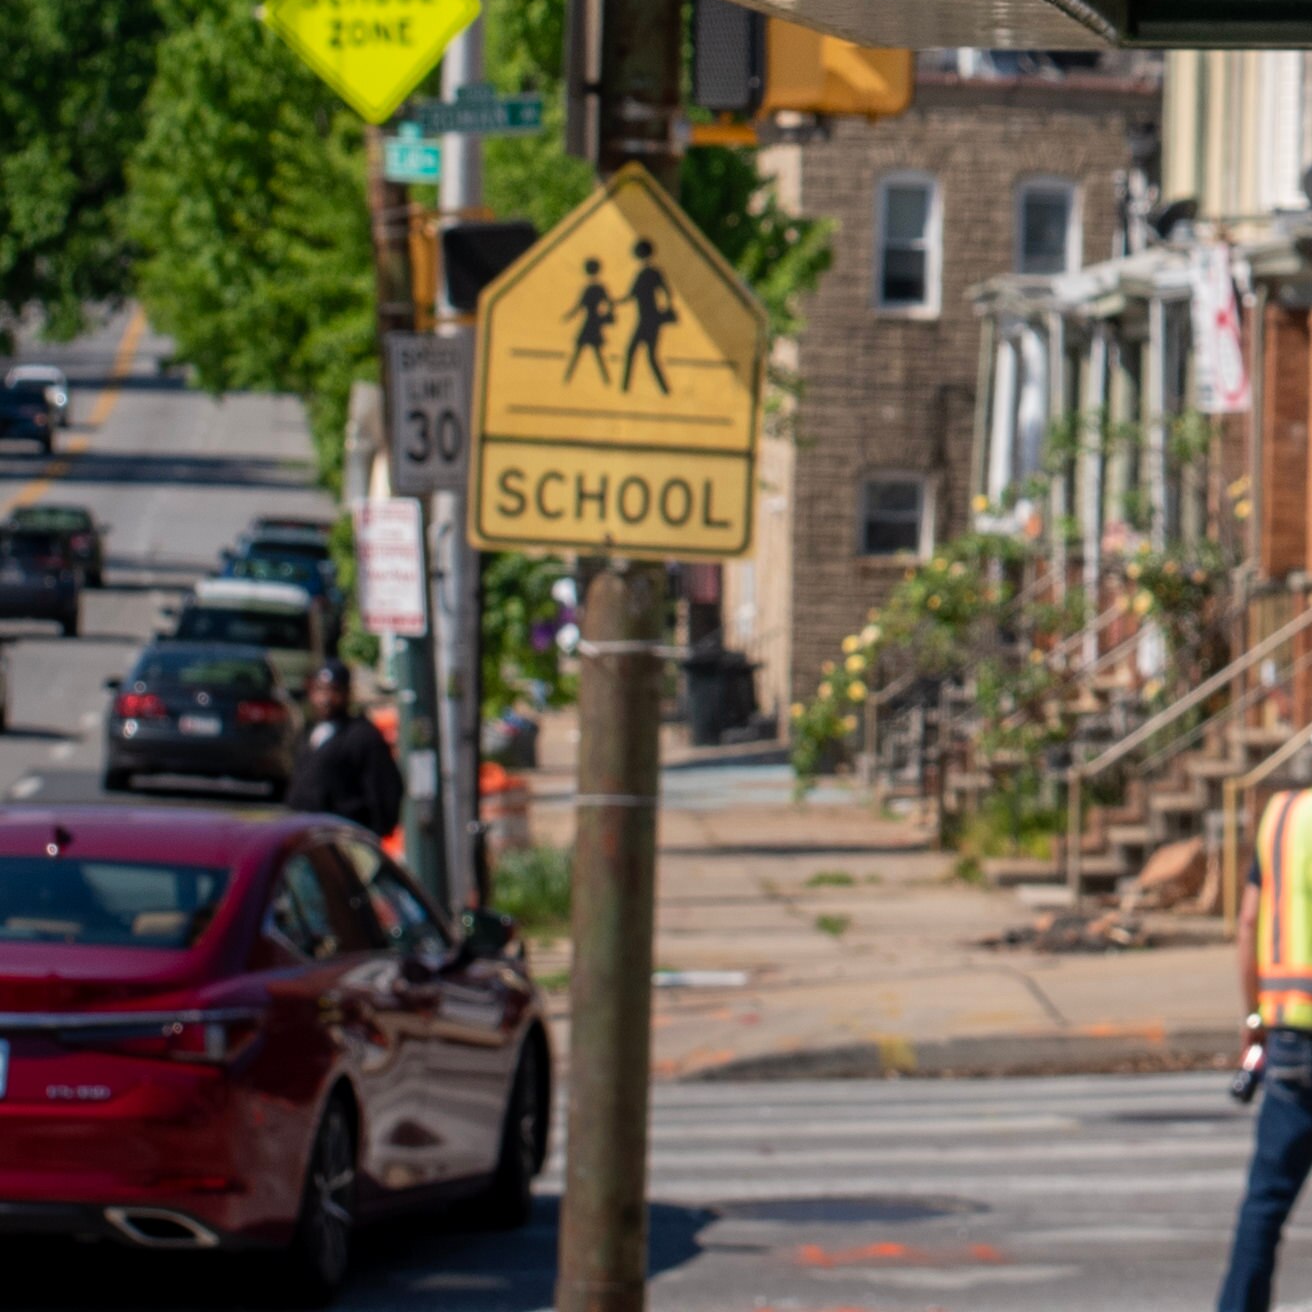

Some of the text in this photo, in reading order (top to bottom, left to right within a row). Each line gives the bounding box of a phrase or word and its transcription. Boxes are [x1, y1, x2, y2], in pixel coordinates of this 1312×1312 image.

[328, 18, 413, 49] ZONE
[406, 409, 463, 465] 30
[496, 467, 733, 530] SCHOOL
